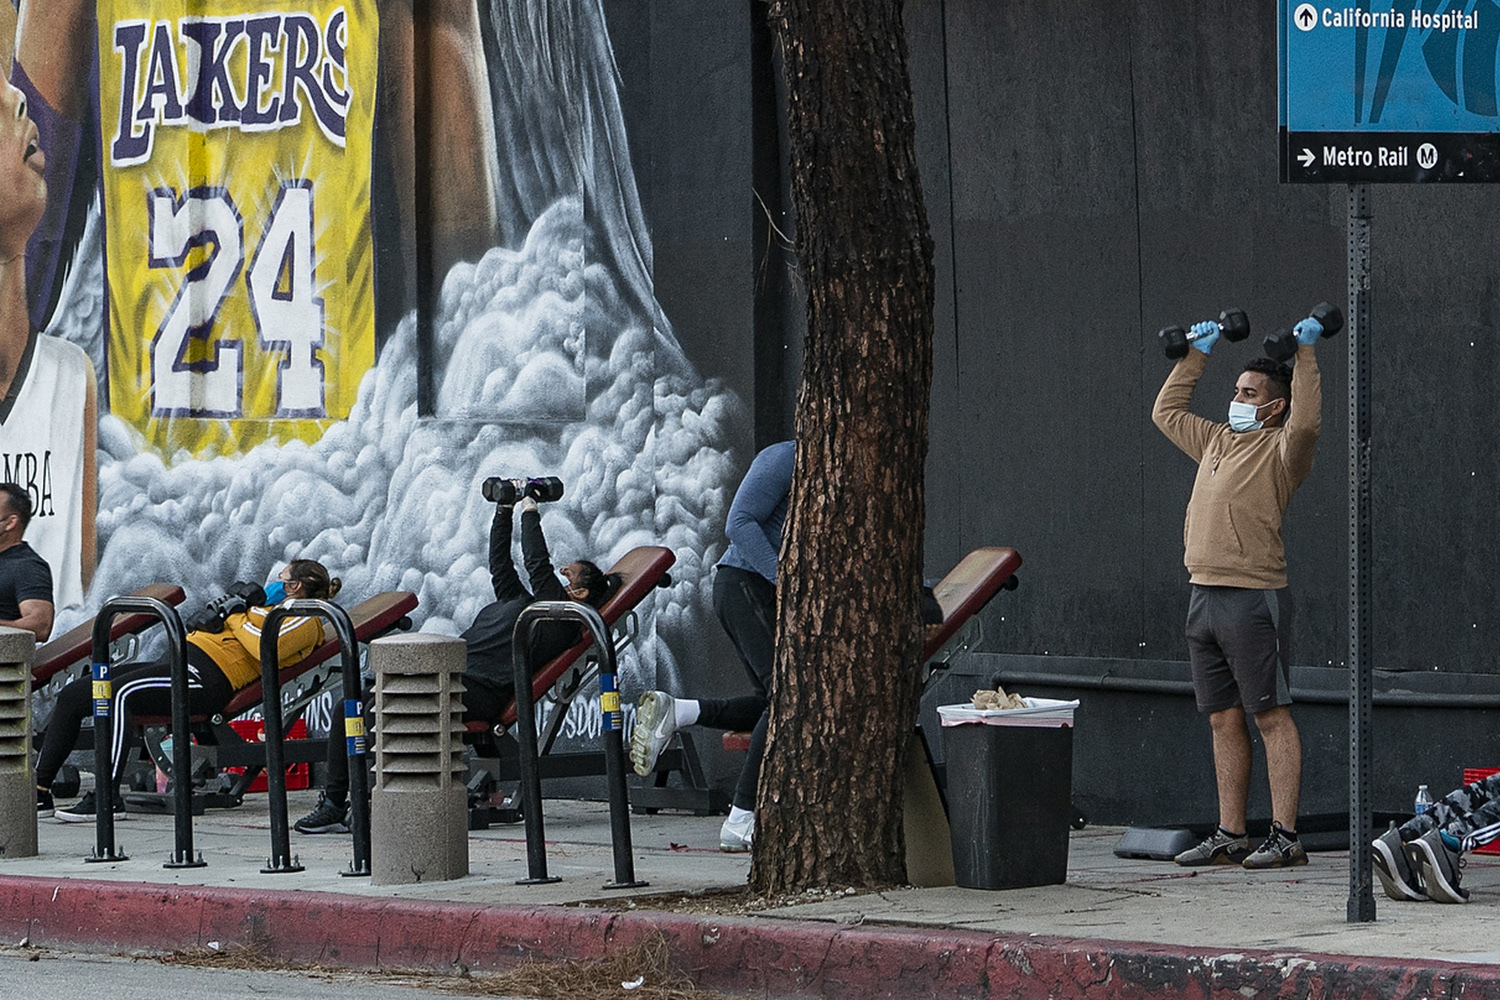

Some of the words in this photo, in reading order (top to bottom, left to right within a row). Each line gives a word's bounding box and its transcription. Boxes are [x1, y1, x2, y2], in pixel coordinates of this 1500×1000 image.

[1322, 7, 1405, 28] California
[1411, 9, 1478, 32] Hospital
[110, 5, 353, 168] LAKERS
[1323, 146, 1373, 166] Metro
[1378, 146, 1408, 166] Rail
[147, 180, 324, 417] 24
